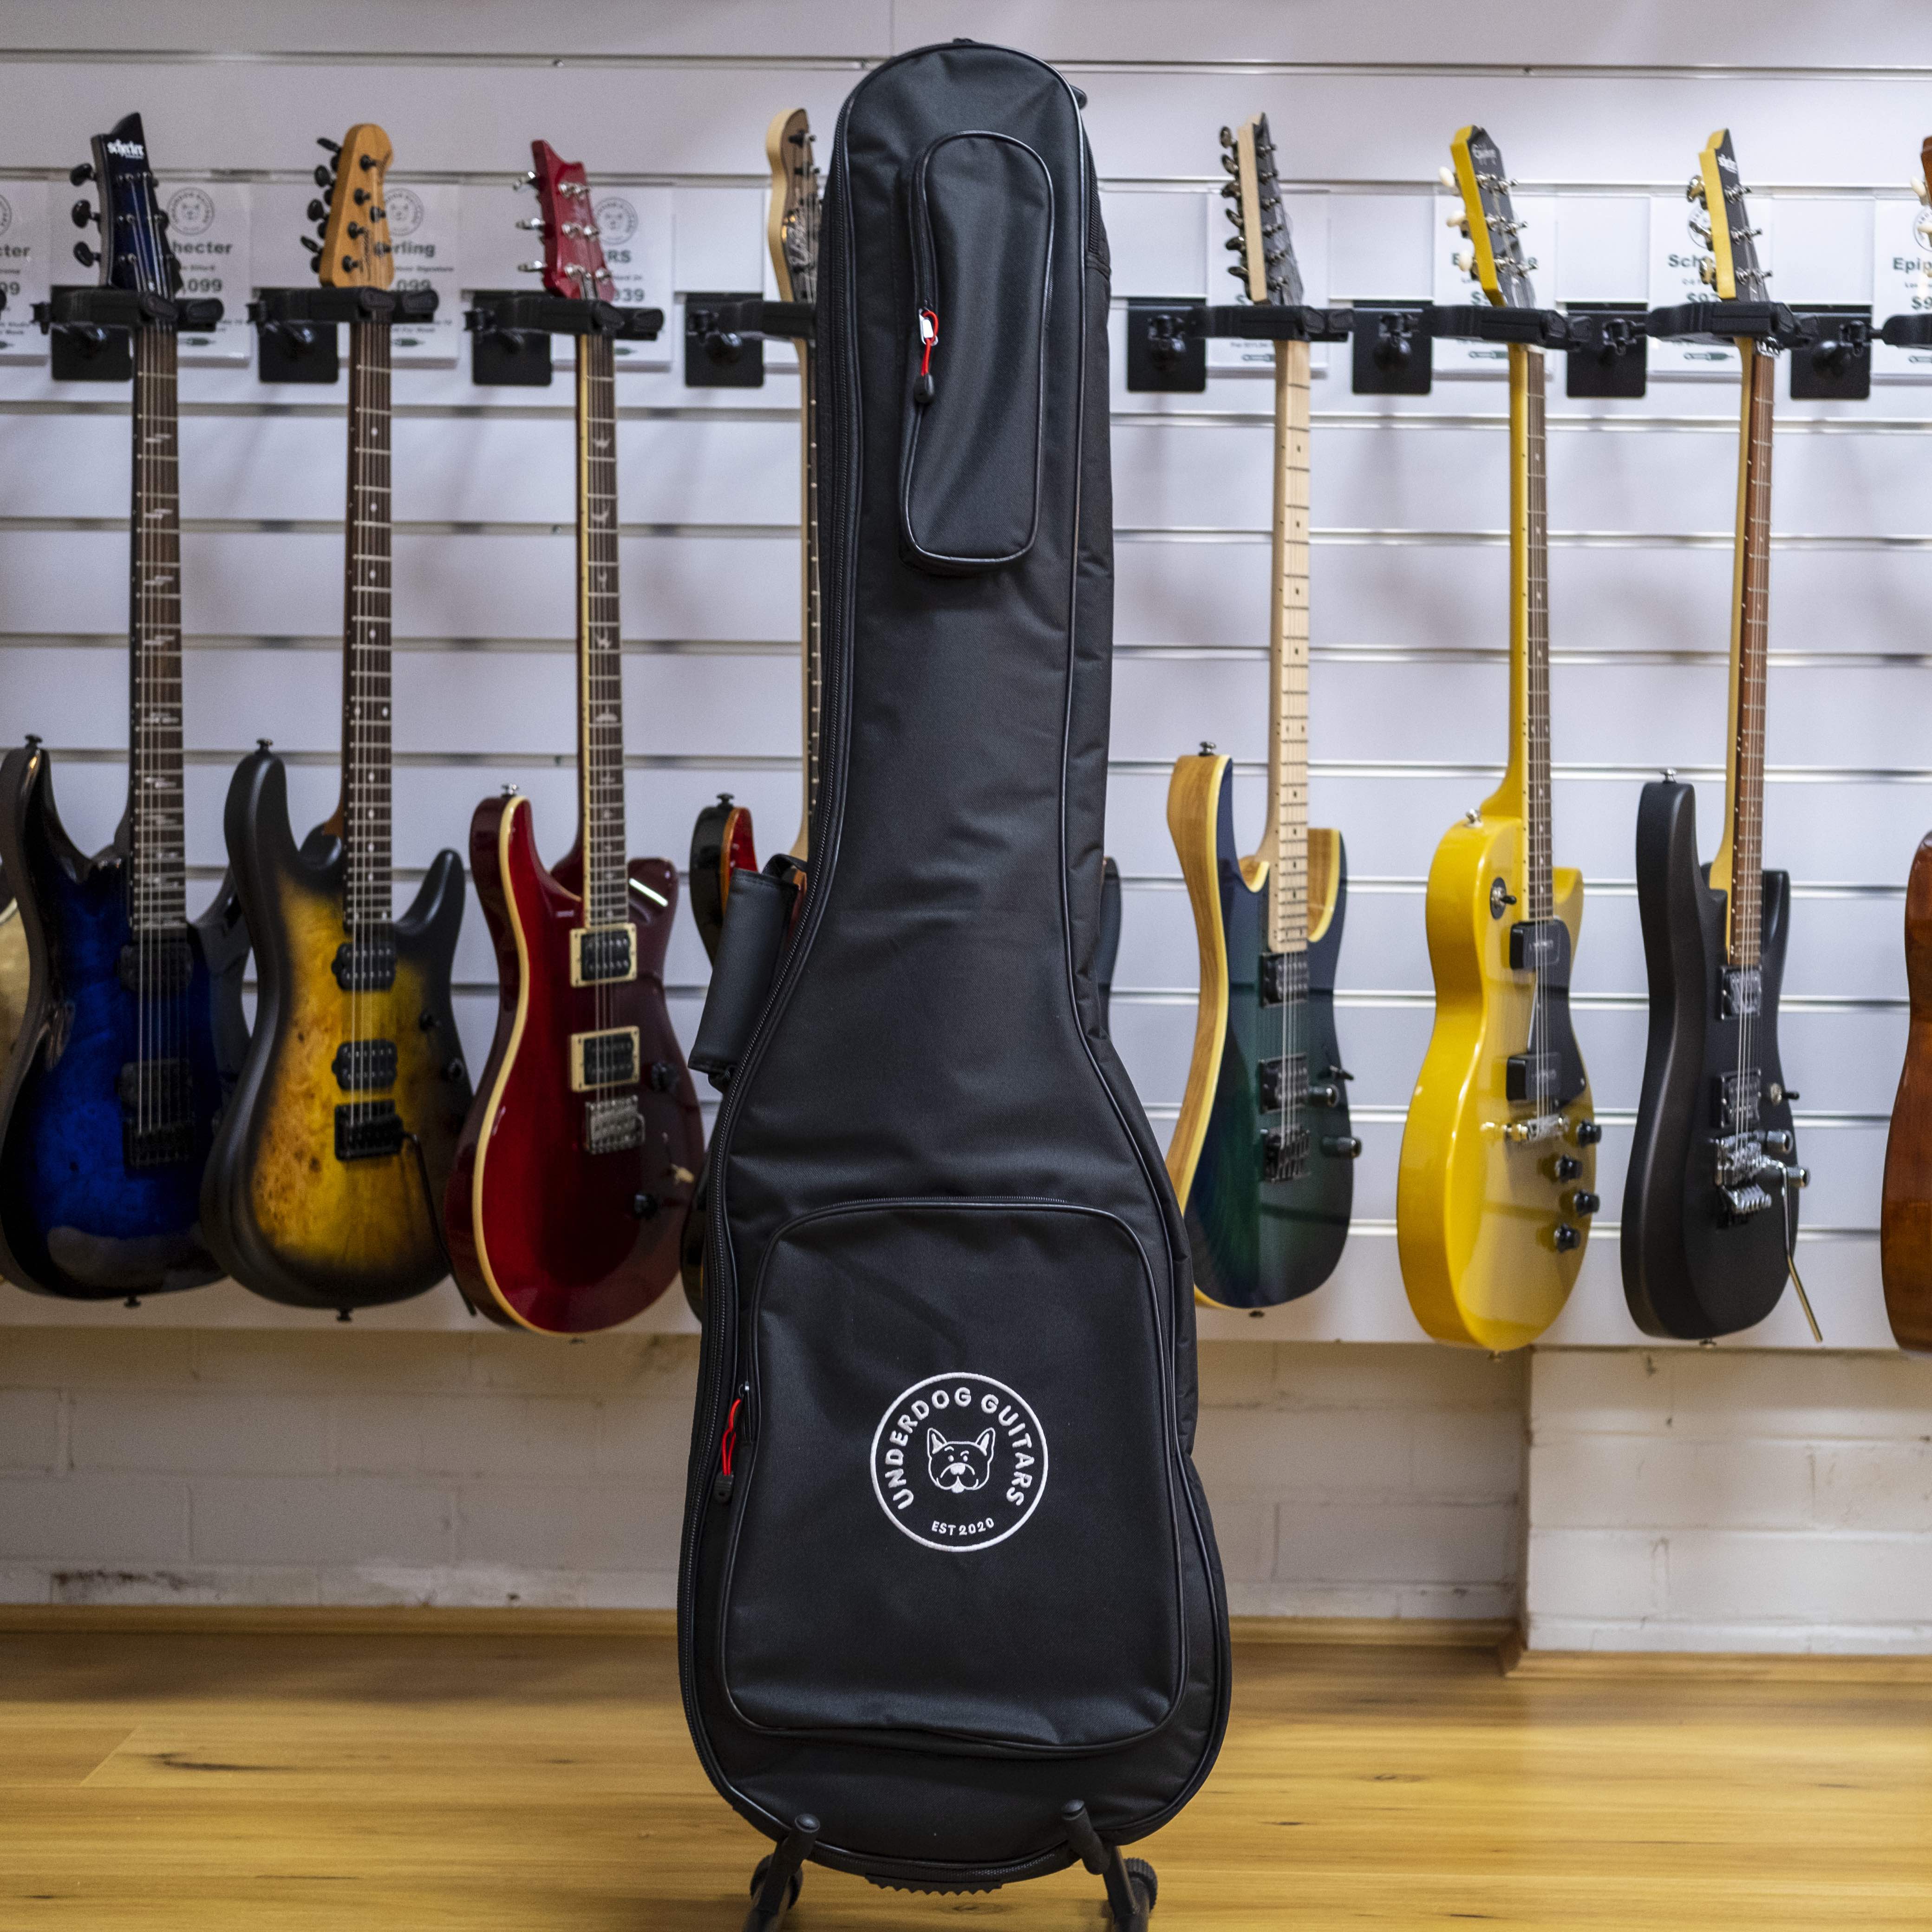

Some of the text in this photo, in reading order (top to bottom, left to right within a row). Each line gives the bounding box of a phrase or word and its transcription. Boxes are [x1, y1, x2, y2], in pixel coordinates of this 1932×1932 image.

[0, 244, 30, 256] ter
[172, 241, 233, 254] hecter
[395, 240, 436, 258] rling
[607, 249, 632, 263] RS
[885, 1387, 1035, 1509] UNDERDOG GUITARS
[931, 1517, 994, 1536] EST 2020
